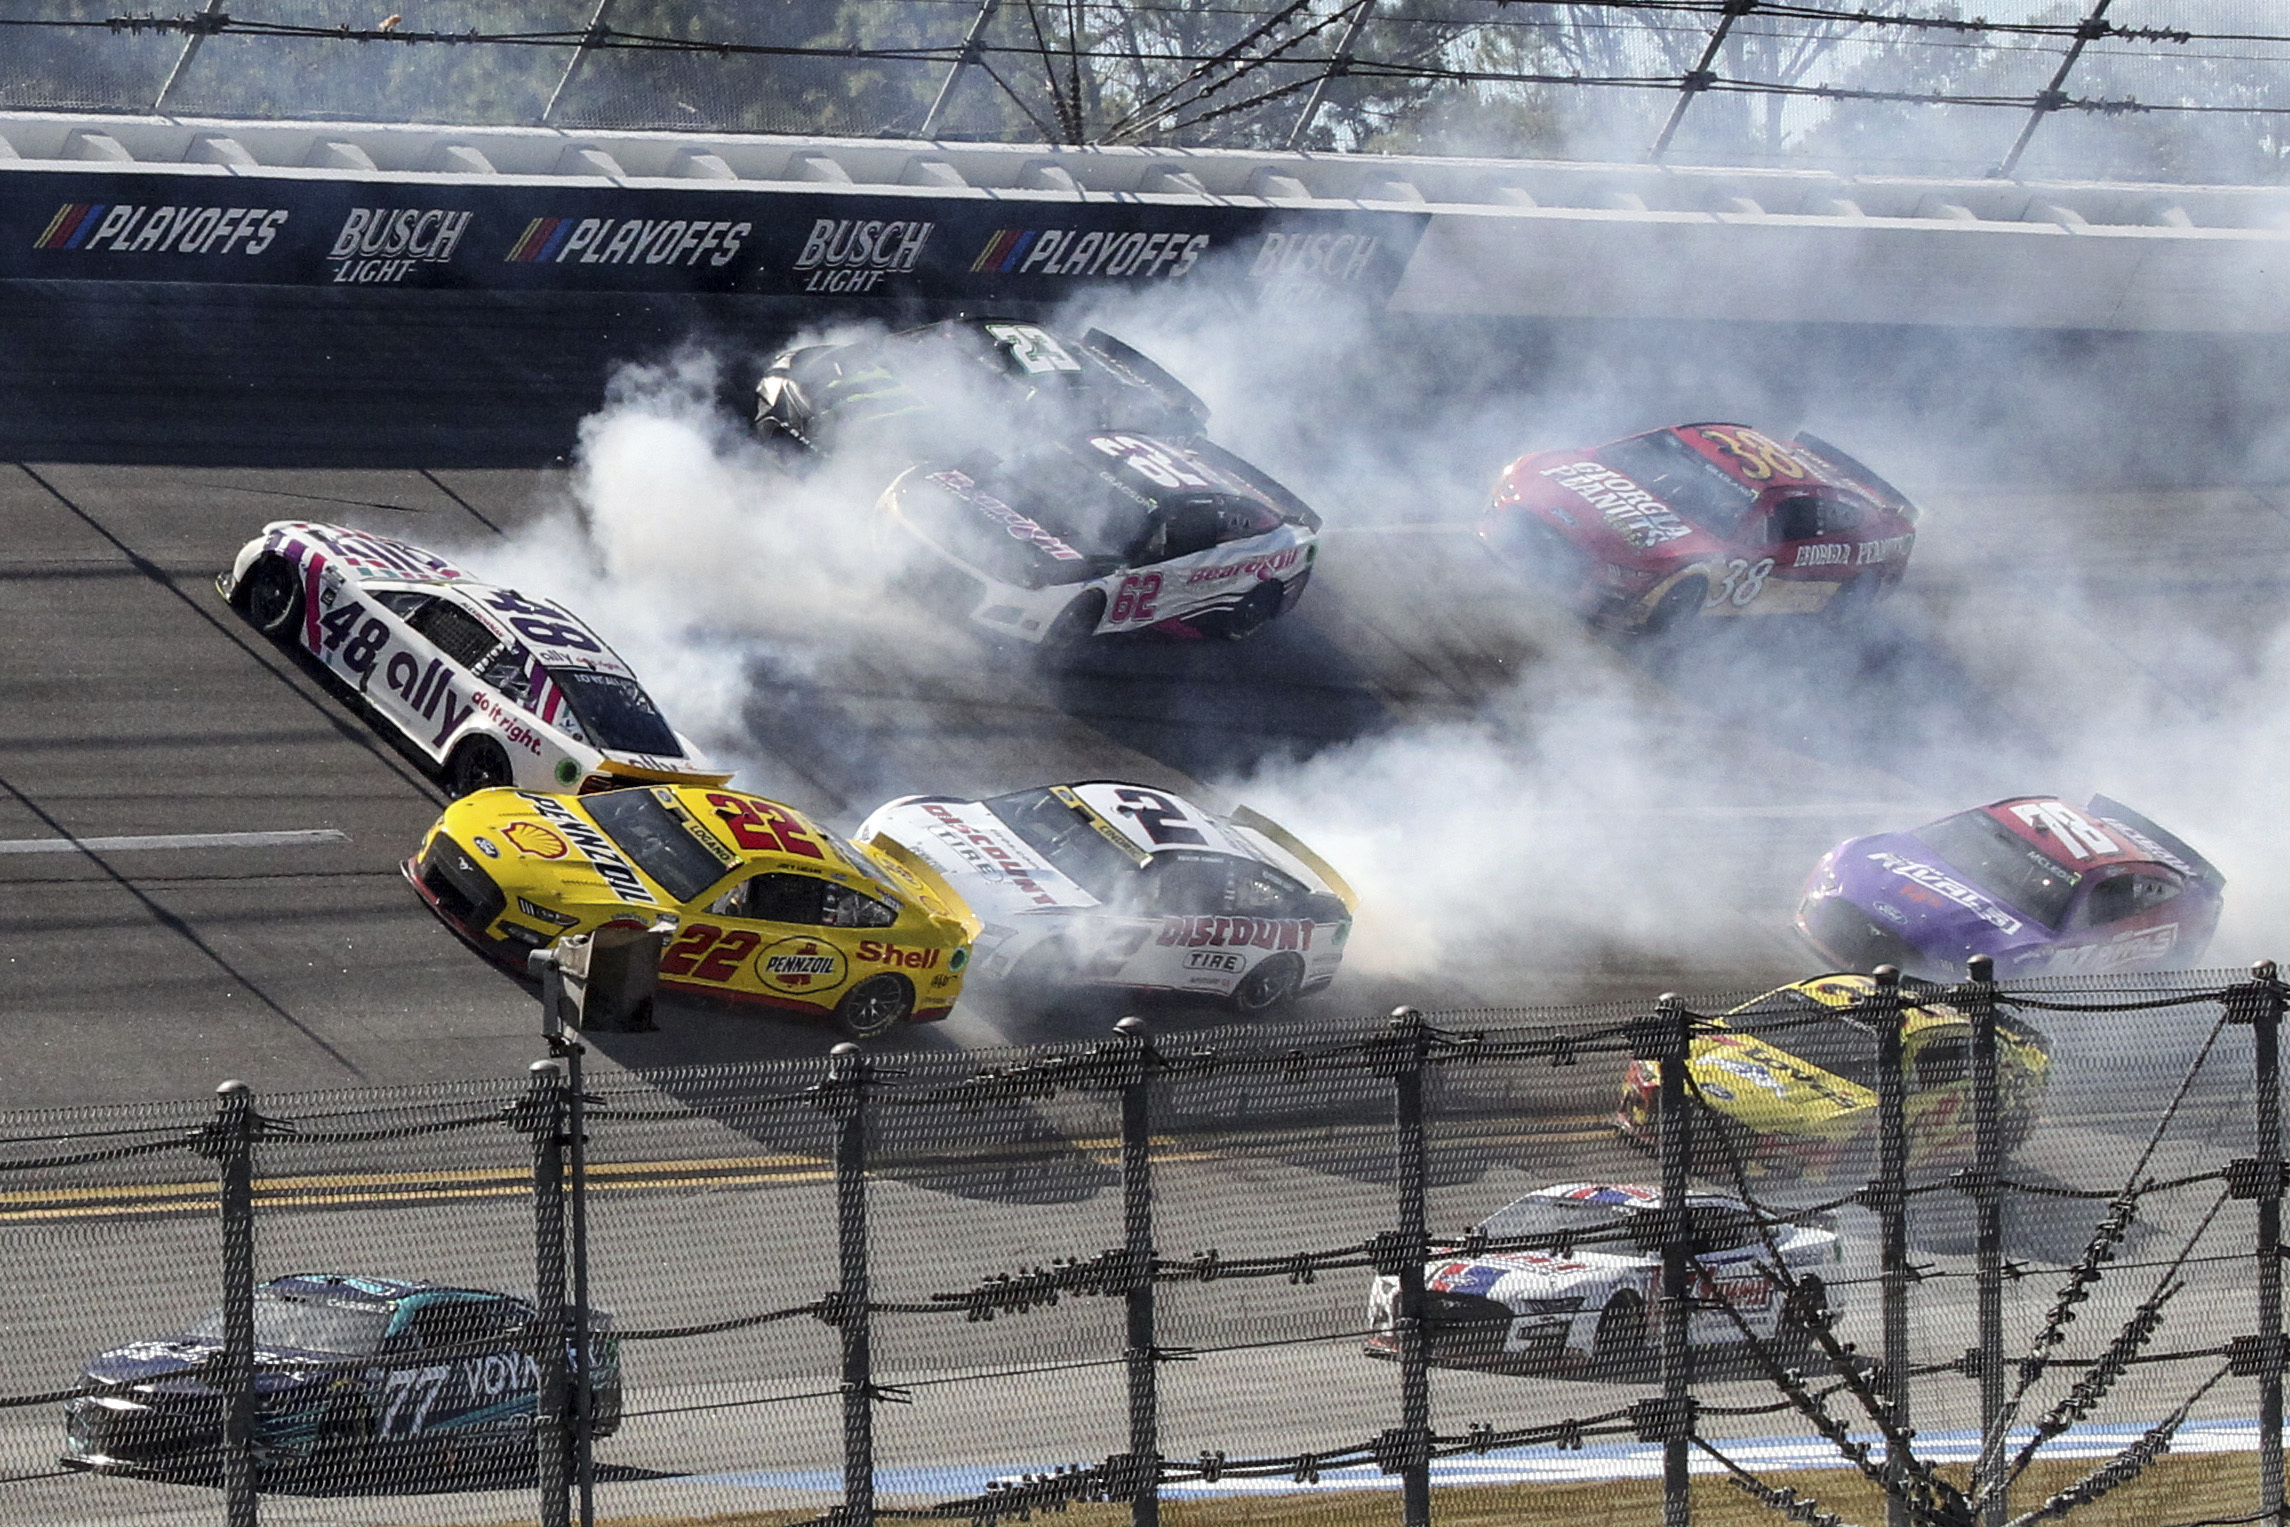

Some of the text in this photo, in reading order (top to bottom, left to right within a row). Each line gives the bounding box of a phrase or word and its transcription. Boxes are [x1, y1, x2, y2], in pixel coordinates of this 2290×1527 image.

[86, 205, 289, 255] PLAYOFFS
[327, 208, 474, 262] BUSCH
[556, 218, 752, 267] PLAYOFFS
[795, 219, 935, 272] BUSCH
[1020, 230, 1209, 277] PLAYOFFS
[334, 260, 412, 284] LIGHT
[805, 271, 882, 293] LIGHT
[1246, 232, 1379, 282] BUSCH
[984, 324, 1084, 376] 23
[1700, 430, 1805, 481] 38
[1572, 461, 1693, 541] GEORGIA
[1793, 542, 1851, 567] GEORGIA
[1110, 571, 1163, 623] 62
[1702, 557, 1776, 609] 38
[319, 601, 391, 673] 48
[482, 590, 602, 654] 48
[386, 651, 475, 749] ally
[472, 691, 490, 712] do
[489, 703, 503, 722] it
[705, 793, 825, 862] 22
[1099, 824, 1139, 858] CINDRIC
[1113, 788, 1210, 846] 2
[2008, 801, 2120, 860] 78
[515, 791, 659, 905] PENNZOIL
[690, 824, 731, 863] LOGANO
[920, 805, 1058, 905] DISCOUNT
[937, 830, 997, 876] TIRE
[659, 922, 761, 982] 22
[855, 940, 941, 970] Shell
[1156, 916, 1316, 951] DISCOUNT
[765, 955, 835, 975] PENNZOIL
[1190, 953, 1237, 971] TIRE
[374, 1364, 451, 1437] 77
